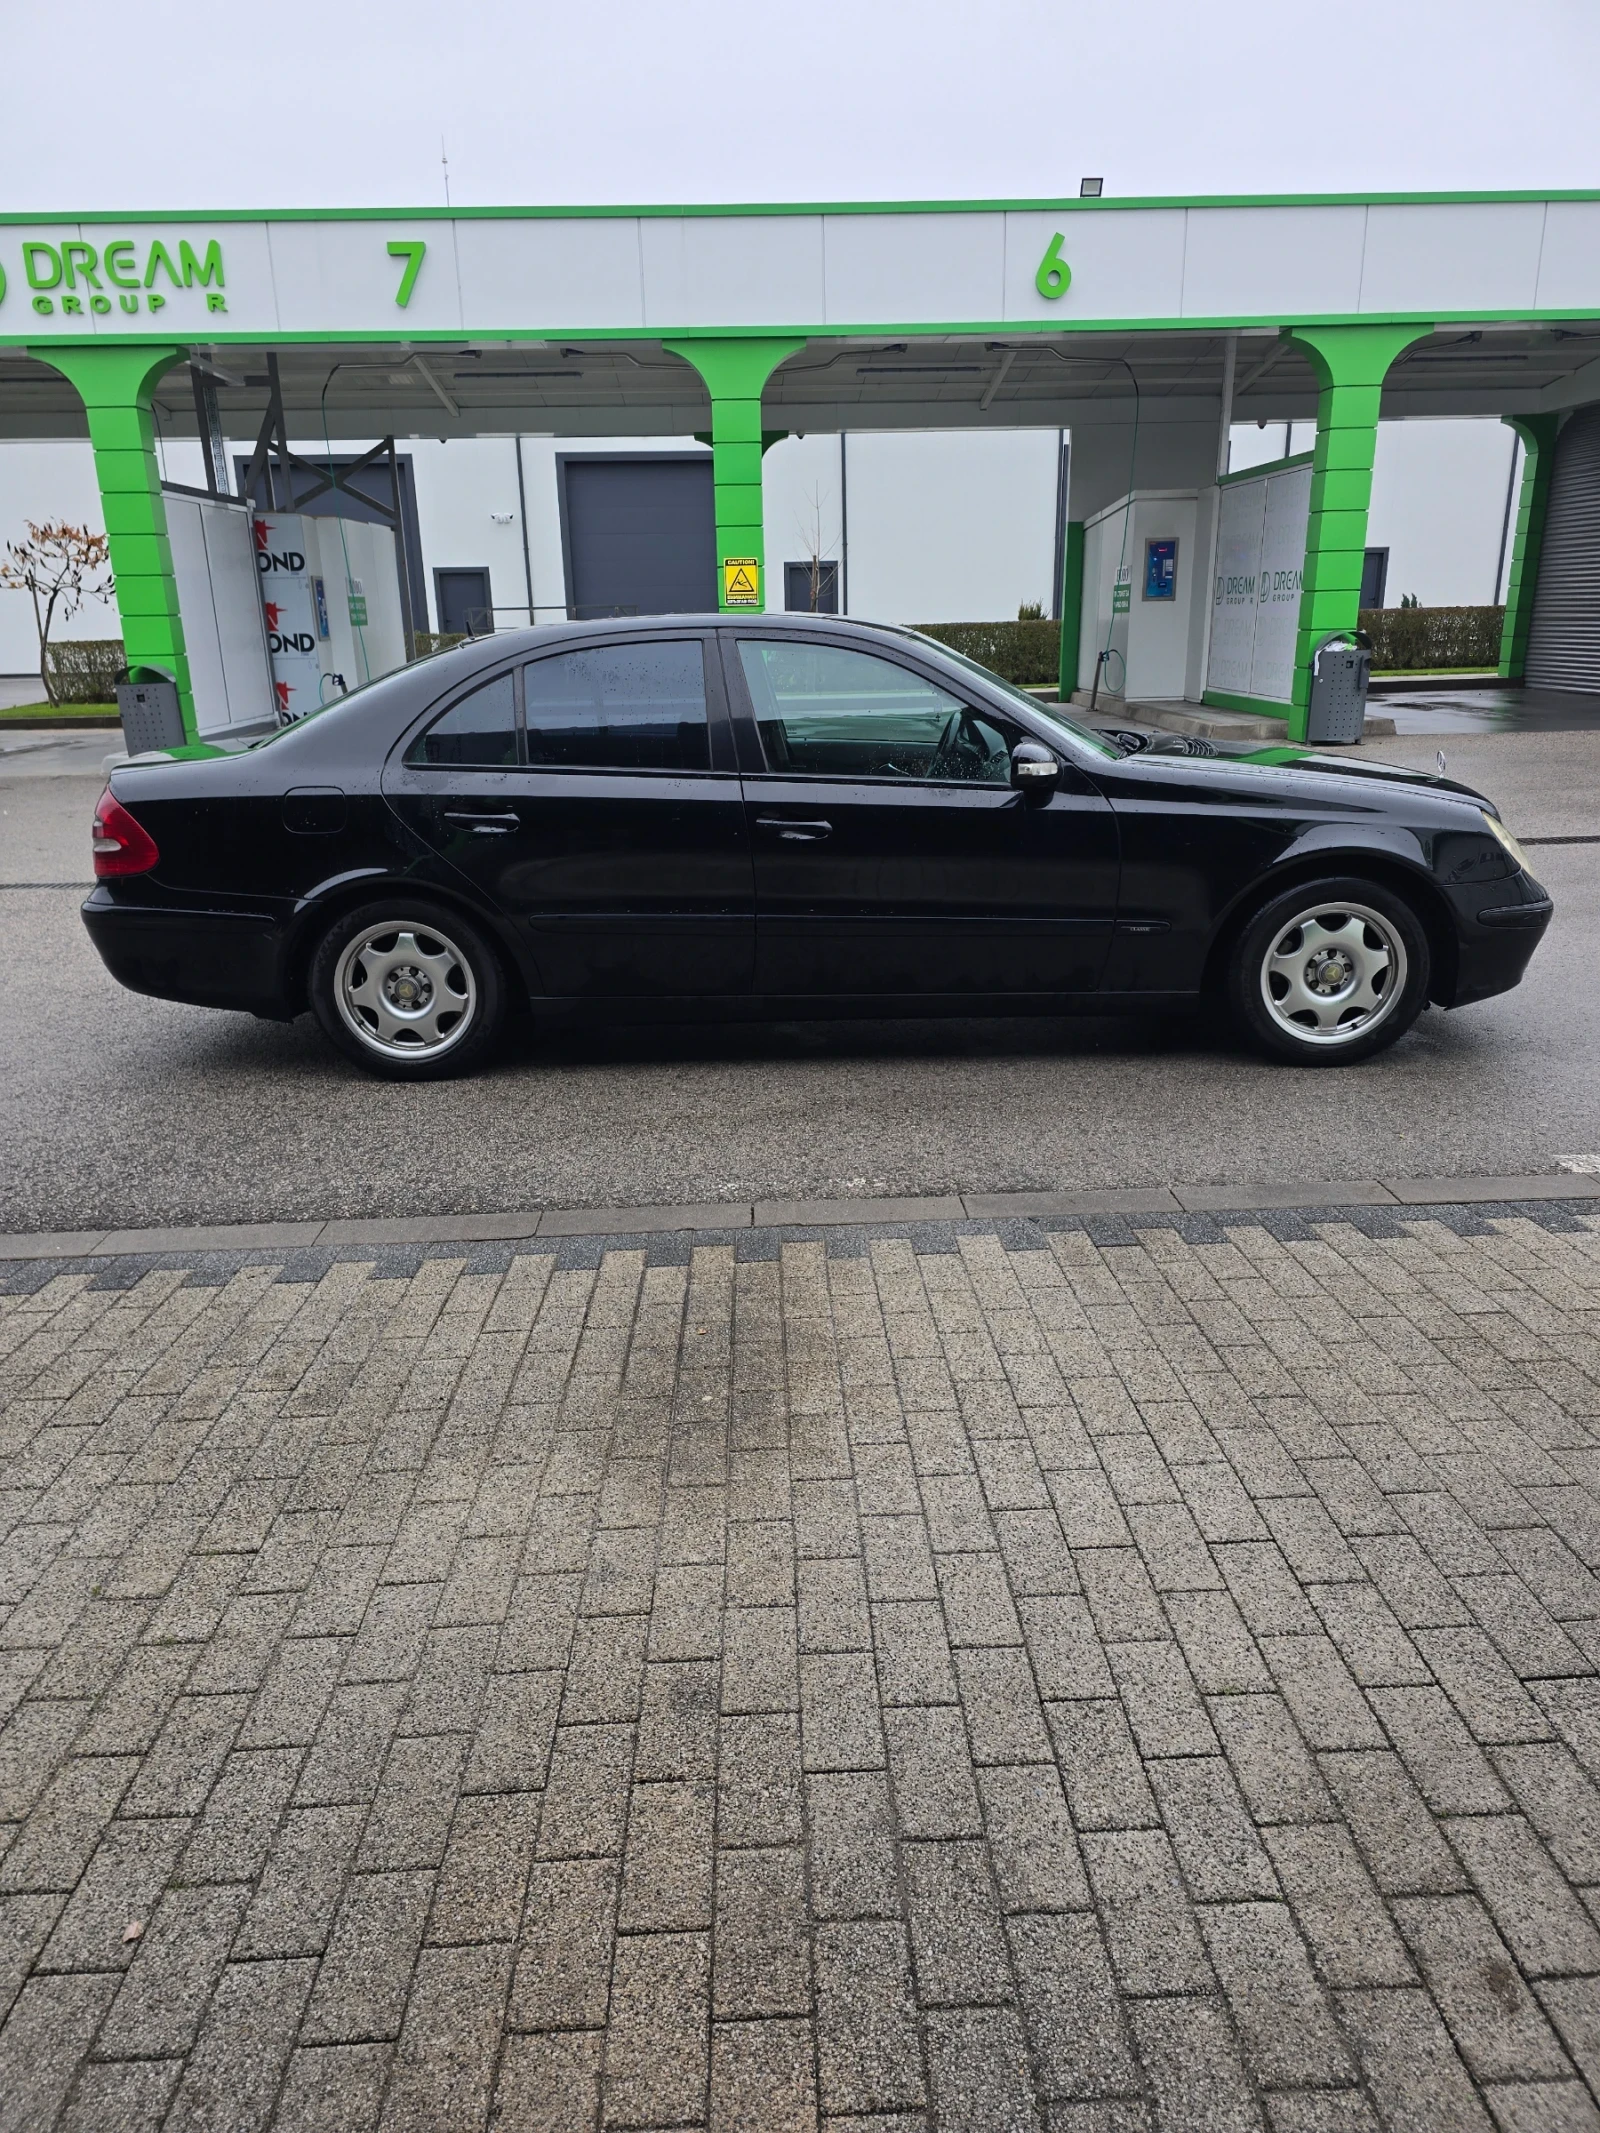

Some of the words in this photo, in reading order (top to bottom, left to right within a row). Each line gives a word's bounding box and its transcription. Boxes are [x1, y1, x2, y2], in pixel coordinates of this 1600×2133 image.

[22, 239, 225, 290] DREAM
[387, 241, 426, 308] 7
[1035, 232, 1071, 299] 6
[32, 294, 165, 314] GROUP
[206, 293, 228, 312] R
[1227, 576, 1256, 595] DREAM
[1226, 597, 1245, 605] GROUP
[1272, 594, 1295, 602] GROUP
